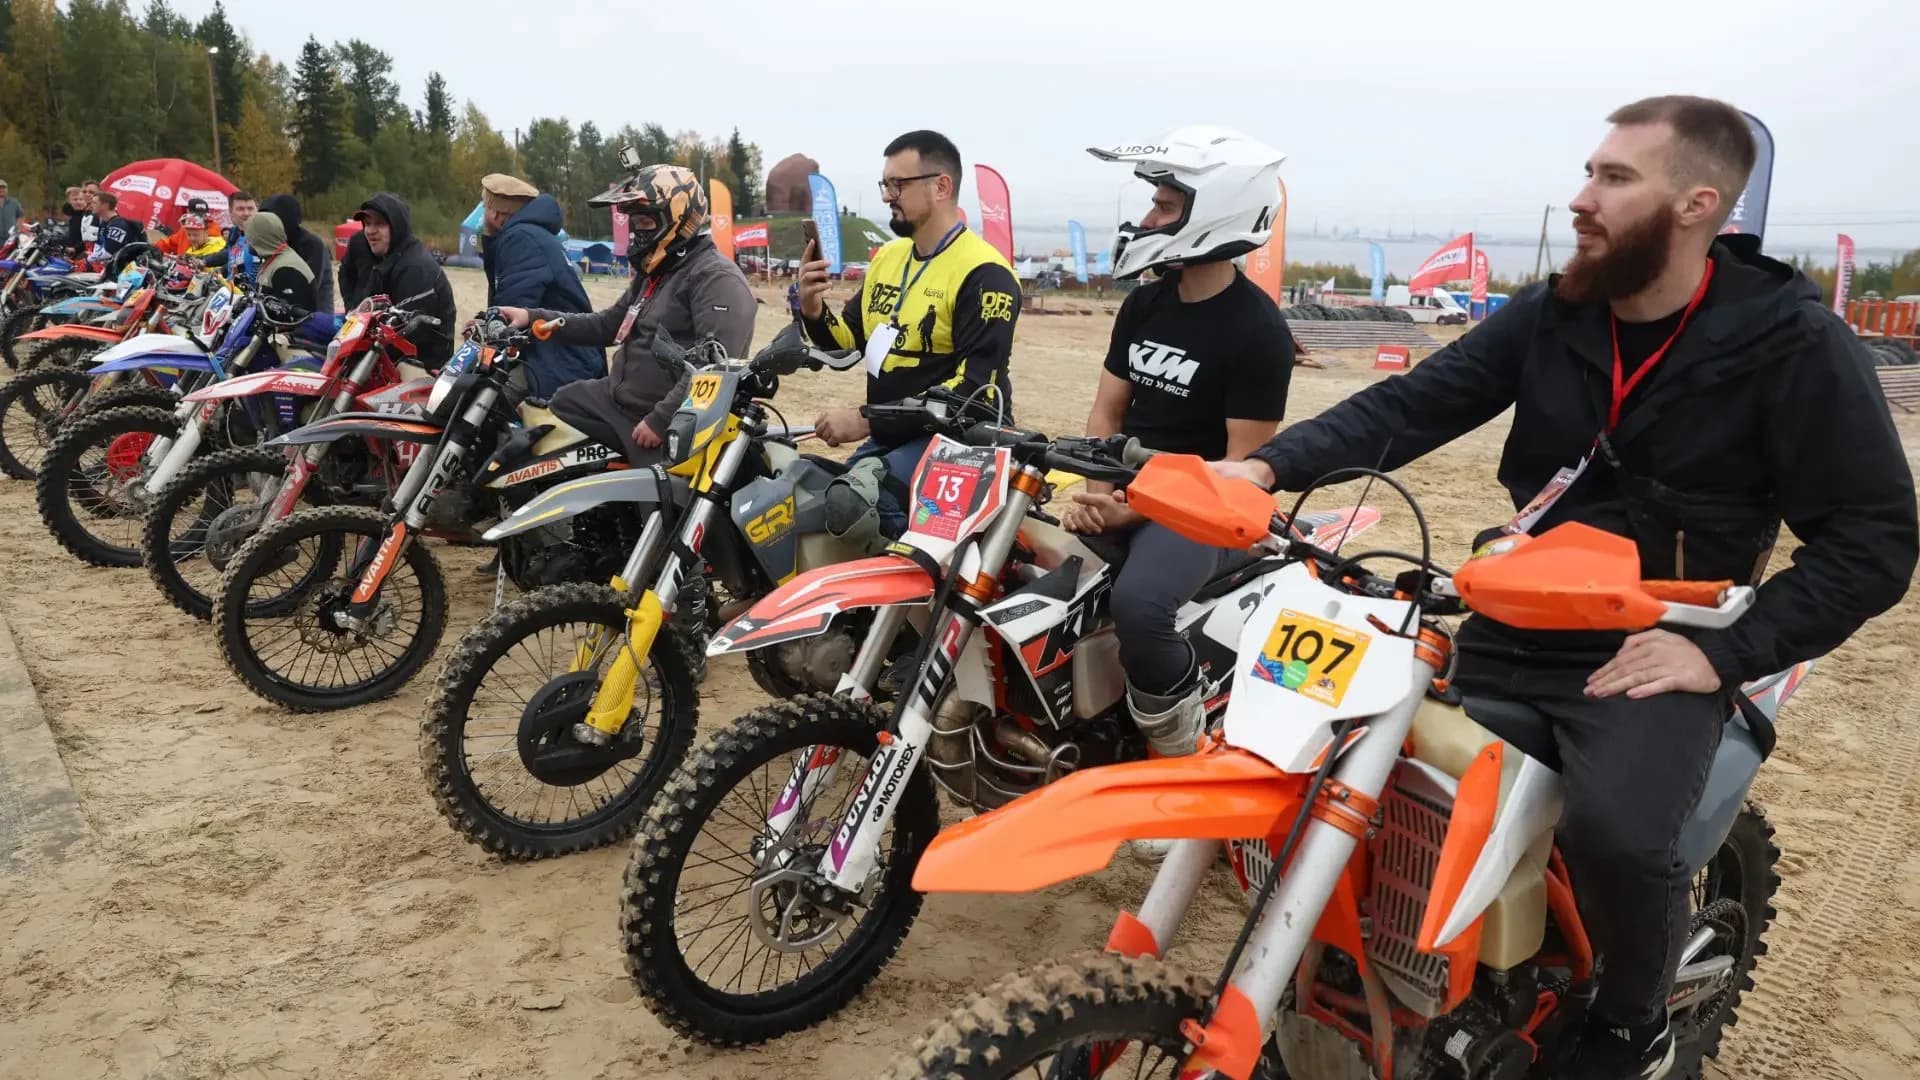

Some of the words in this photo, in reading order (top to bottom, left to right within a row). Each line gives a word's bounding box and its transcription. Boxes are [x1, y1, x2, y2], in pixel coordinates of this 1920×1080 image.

[1111, 145, 1169, 155] AIROH
[981, 291, 1013, 311] OFF
[981, 307, 1012, 323] ROAD
[1128, 339, 1201, 386] KTM
[693, 380, 717, 399] 101
[1140, 376, 1155, 387] TO
[504, 460, 558, 485] AVANTIS
[576, 446, 609, 462] PRO
[935, 474, 964, 502] 13
[1276, 623, 1356, 675] 107
[879, 743, 918, 806] MOTOREX
